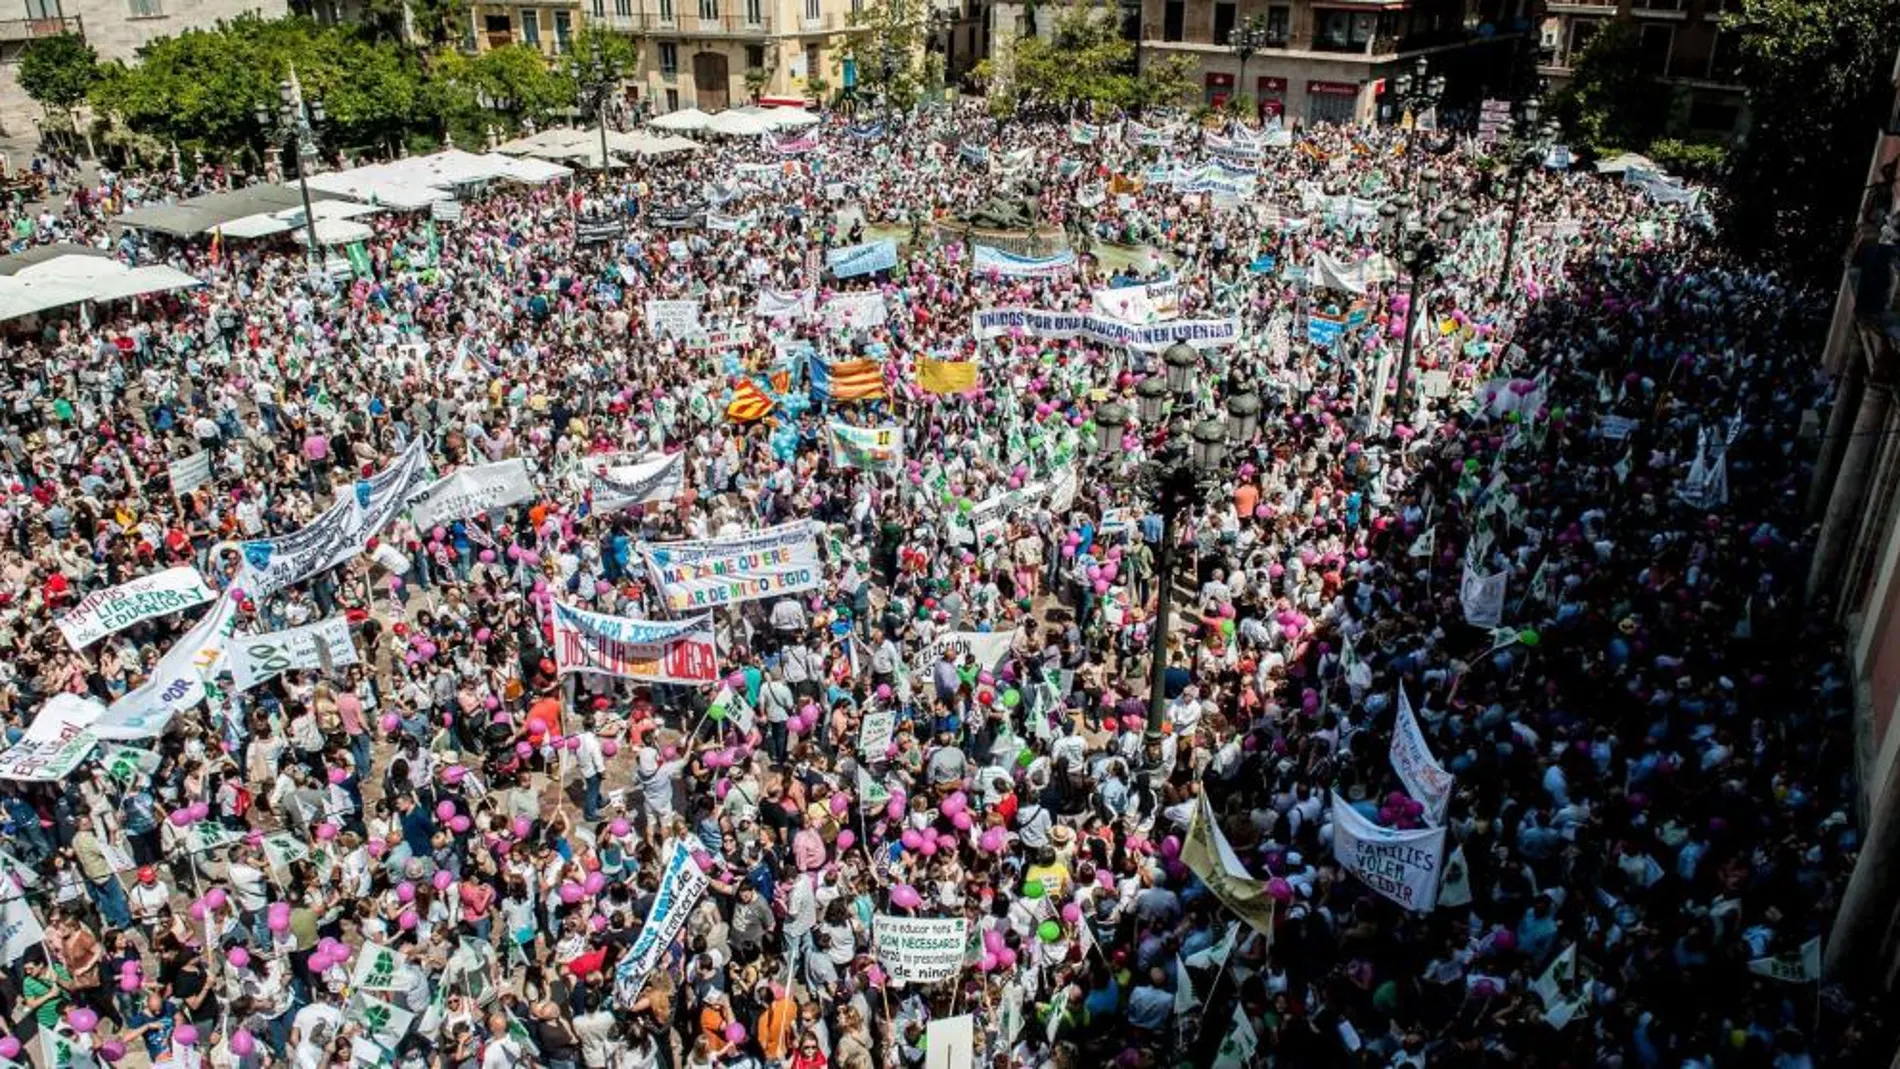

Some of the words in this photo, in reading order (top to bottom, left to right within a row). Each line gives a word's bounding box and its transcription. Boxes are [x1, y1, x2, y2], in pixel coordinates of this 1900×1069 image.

[980, 311, 1024, 329] UNIDOS
[1027, 313, 1051, 330] POR
[1054, 315, 1081, 329] UNA
[1082, 316, 1150, 343] EDUCACIÓN
[1153, 327, 1170, 342] EN
[1171, 322, 1233, 342] LIBERTAD
[407, 490, 430, 508] NO
[713, 559, 736, 575] ME
[739, 547, 791, 570] QUERE
[708, 586, 729, 601] DE
[731, 582, 747, 598] MI
[1357, 840, 1434, 872] FAMILIES
[1355, 853, 1405, 880] VOLEM
[900, 923, 930, 934] educar
[880, 934, 899, 948] SOM
[902, 937, 961, 949] NECESSARIS
[894, 965, 911, 978] de
